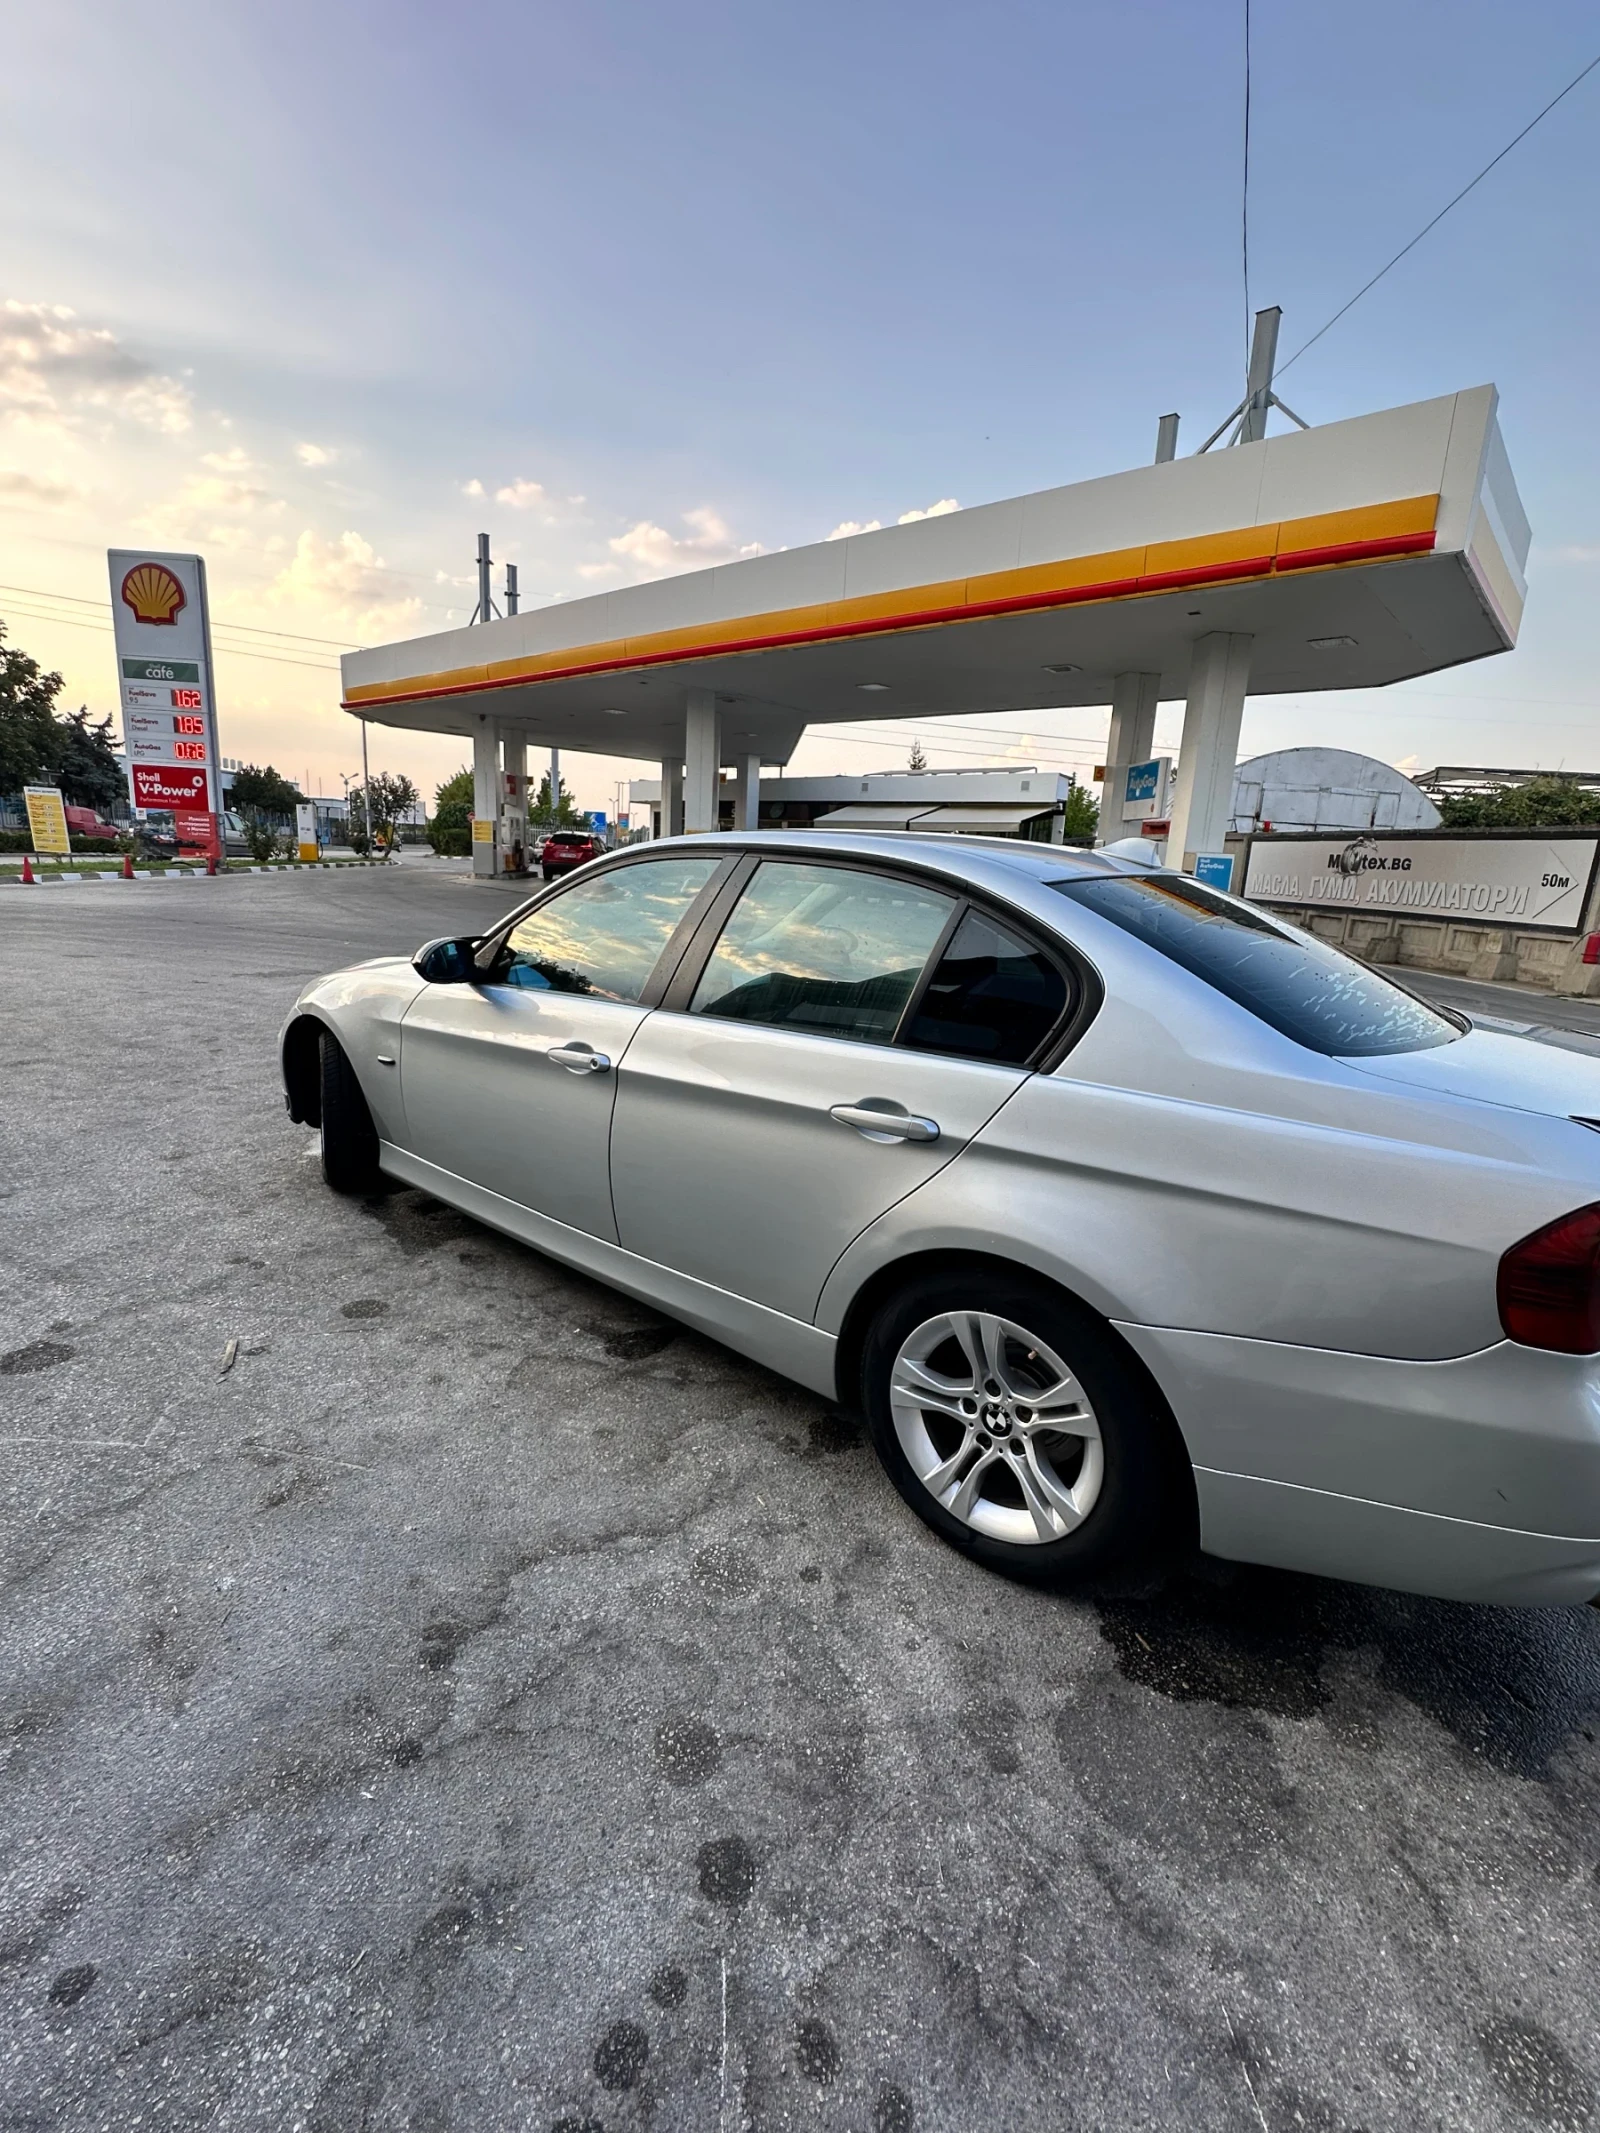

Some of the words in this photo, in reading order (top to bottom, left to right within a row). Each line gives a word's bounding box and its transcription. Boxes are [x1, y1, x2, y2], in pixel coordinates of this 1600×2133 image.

[146, 665, 174, 679] café
[128, 690, 157, 698] FuelSave
[131, 717, 159, 725] FuelSave
[133, 743, 161, 751] AutoGas
[137, 772, 160, 782] Shell
[1129, 774, 1156, 790] AutoGas
[138, 782, 198, 797] V-Power
[1251, 873, 1304, 901] МАСЛА,
[1308, 875, 1361, 906] ГУМИ,
[1365, 878, 1531, 915] АКУМУЛАТОРИ
